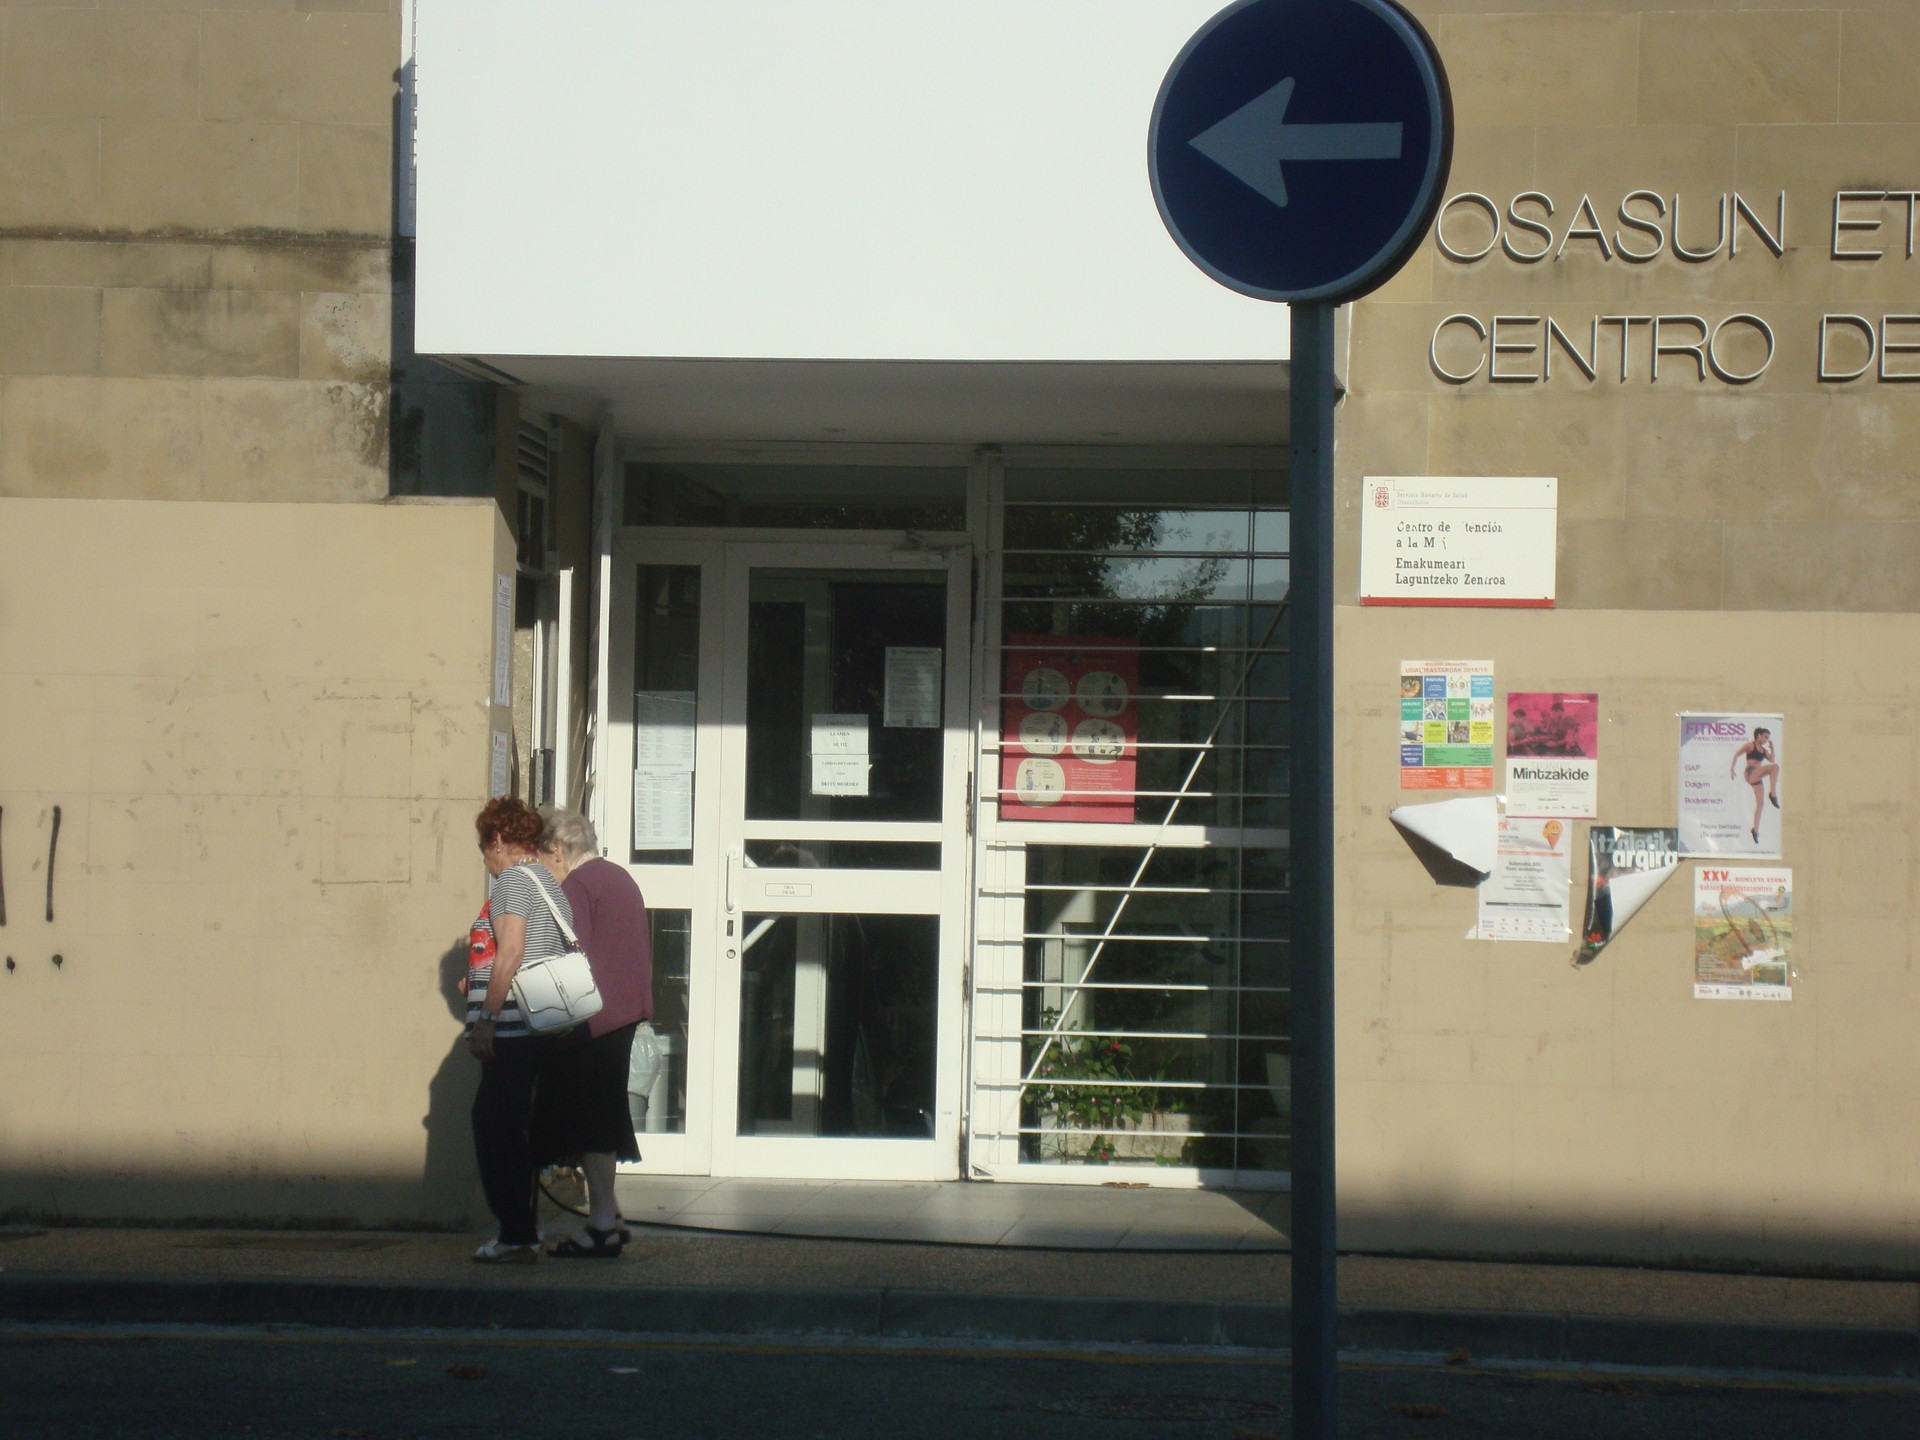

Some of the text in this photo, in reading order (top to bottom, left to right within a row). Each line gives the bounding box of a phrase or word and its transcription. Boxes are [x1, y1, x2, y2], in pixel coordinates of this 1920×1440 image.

[1436, 190, 1920, 260] OSASUN ET
[1430, 313, 1920, 385] CENTRO DE
[1438, 521, 1451, 532] de
[1463, 521, 1503, 532] tención
[1396, 539, 1402, 548] a
[1408, 537, 1418, 548] la
[1395, 557, 1466, 570] Emakumeari
[1395, 573, 1459, 586] Laguntzeko
[1685, 721, 1746, 736] FITNESS
[1513, 767, 1590, 781] Mintzakide
[1703, 870, 1731, 882] XXV.
